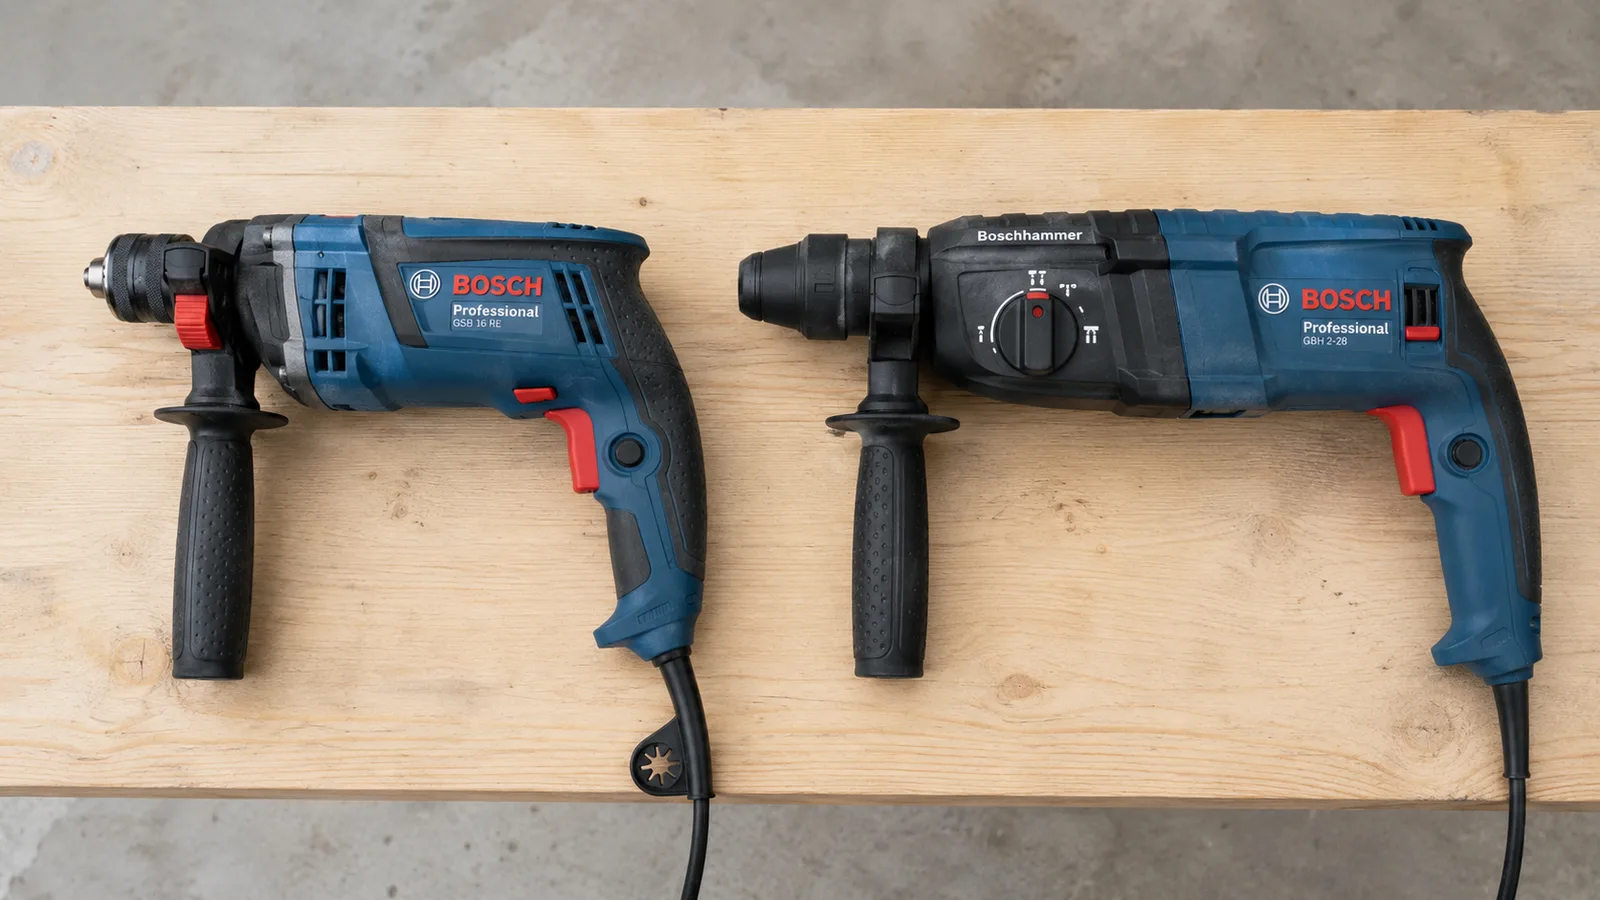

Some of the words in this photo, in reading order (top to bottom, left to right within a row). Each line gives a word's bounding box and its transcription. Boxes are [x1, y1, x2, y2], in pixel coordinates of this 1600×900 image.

[977, 230, 1083, 242] Boschhammer
[452, 274, 543, 296] BOSCH
[1301, 288, 1392, 311] BOSCH
[453, 304, 540, 318] Professional
[476, 319, 487, 328] 16
[1303, 321, 1389, 335] Professional
[1303, 336, 1324, 346] GBH
[1326, 336, 1348, 346] 2-28
